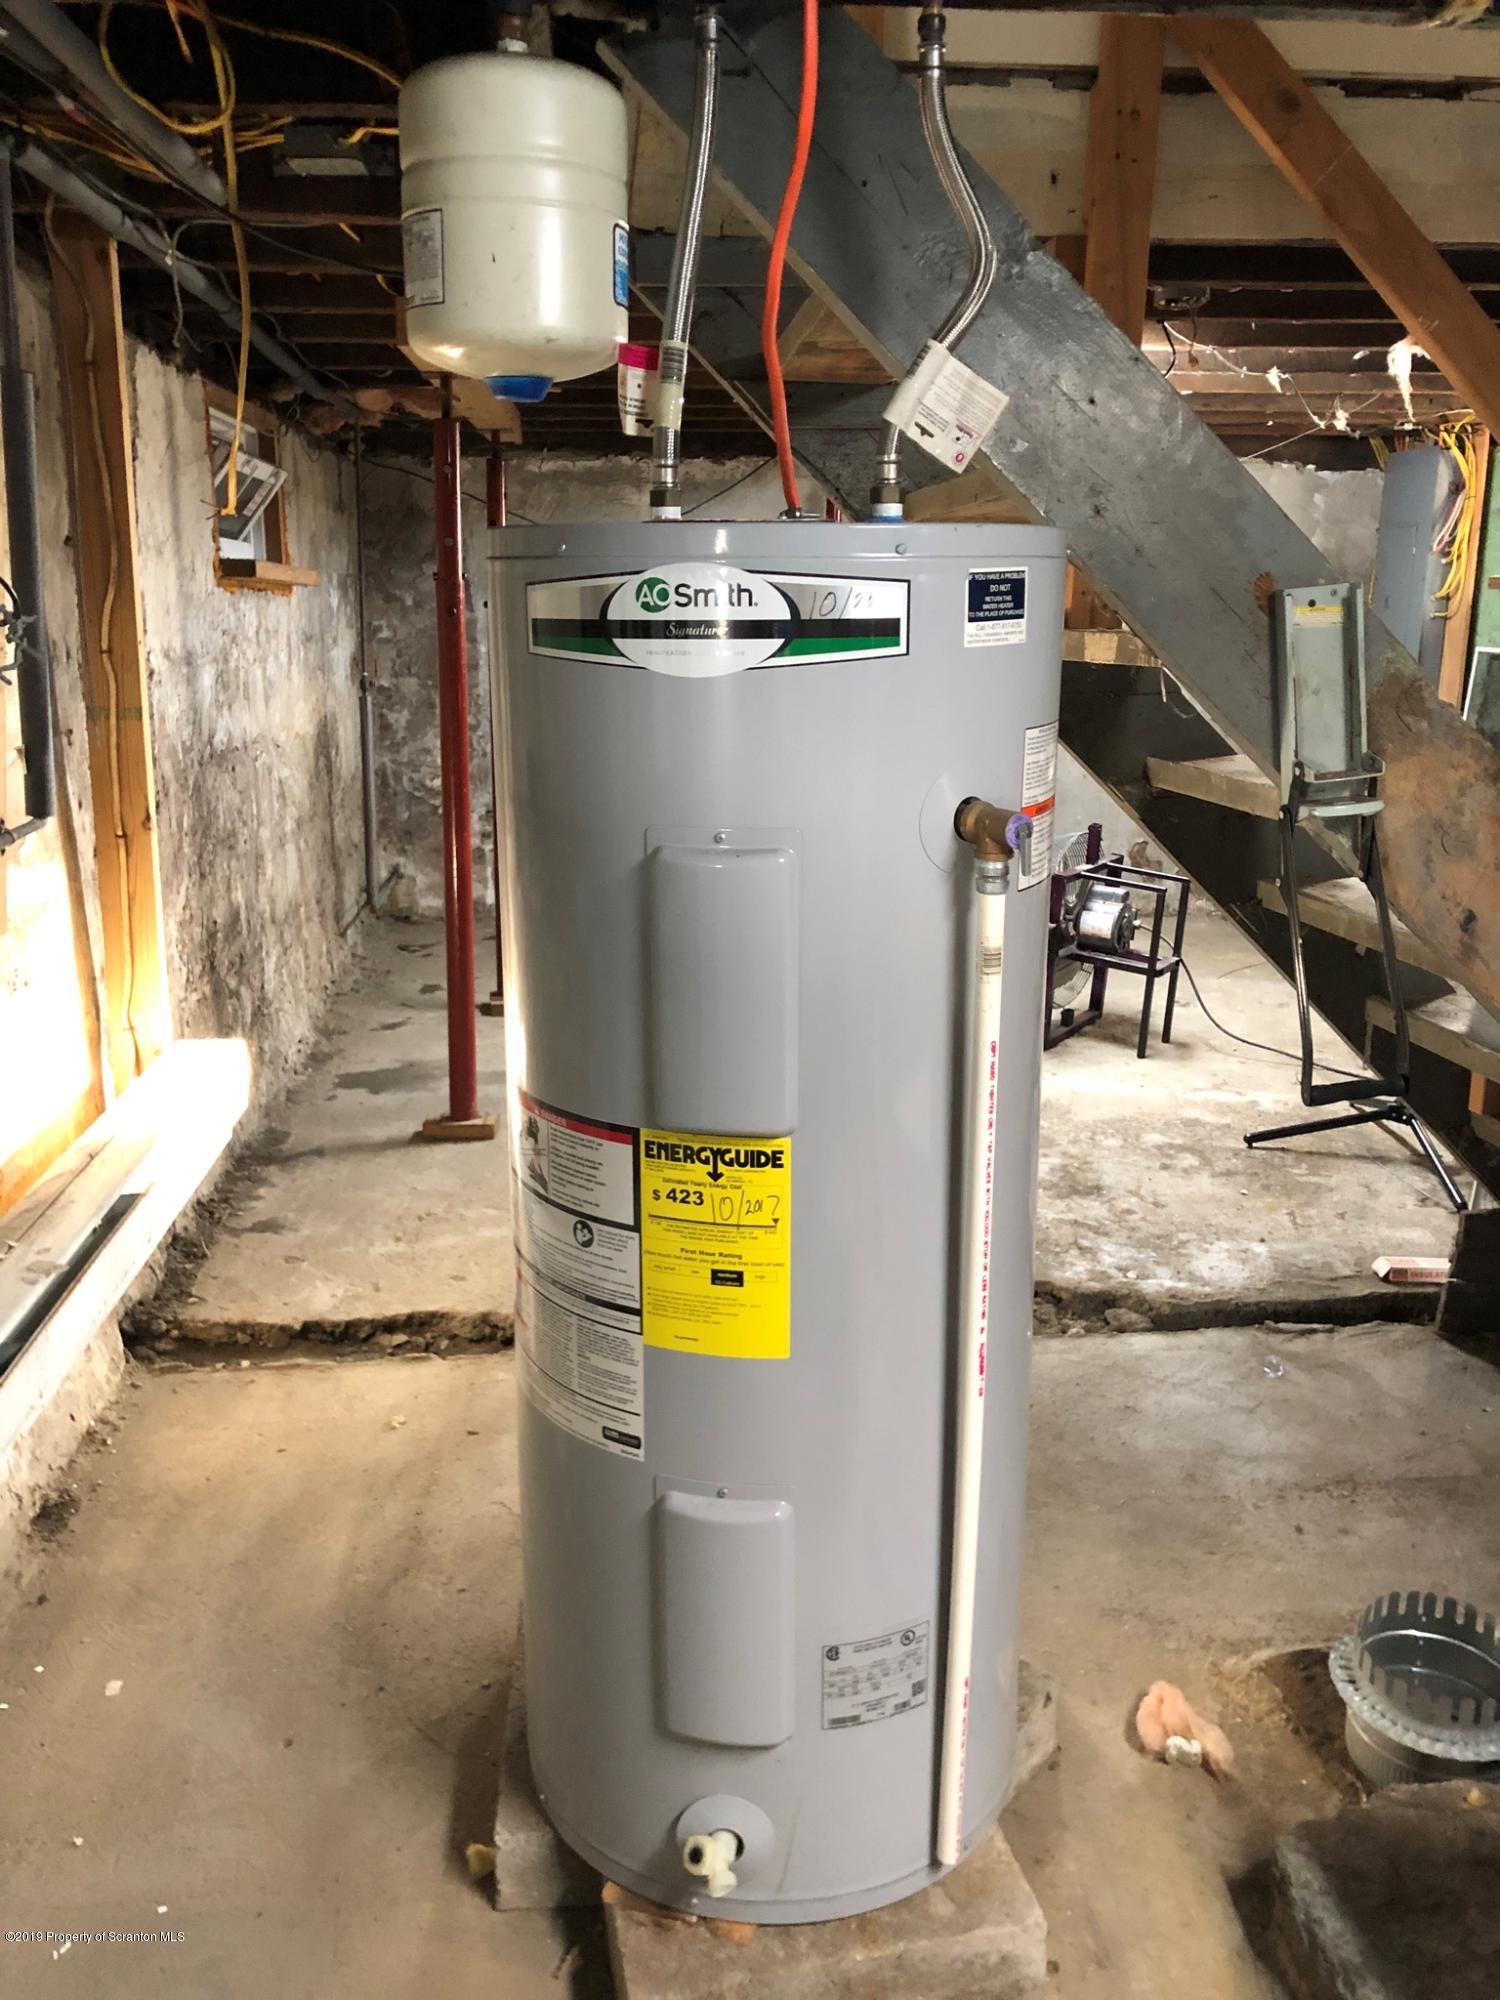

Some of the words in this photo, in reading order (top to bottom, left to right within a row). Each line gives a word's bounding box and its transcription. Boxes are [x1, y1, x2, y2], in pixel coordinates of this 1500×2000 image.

[674, 582, 758, 608] Smth.
[990, 584, 998, 592] DO
[999, 583, 1011, 591] NOT
[666, 1188, 704, 1206] 423
